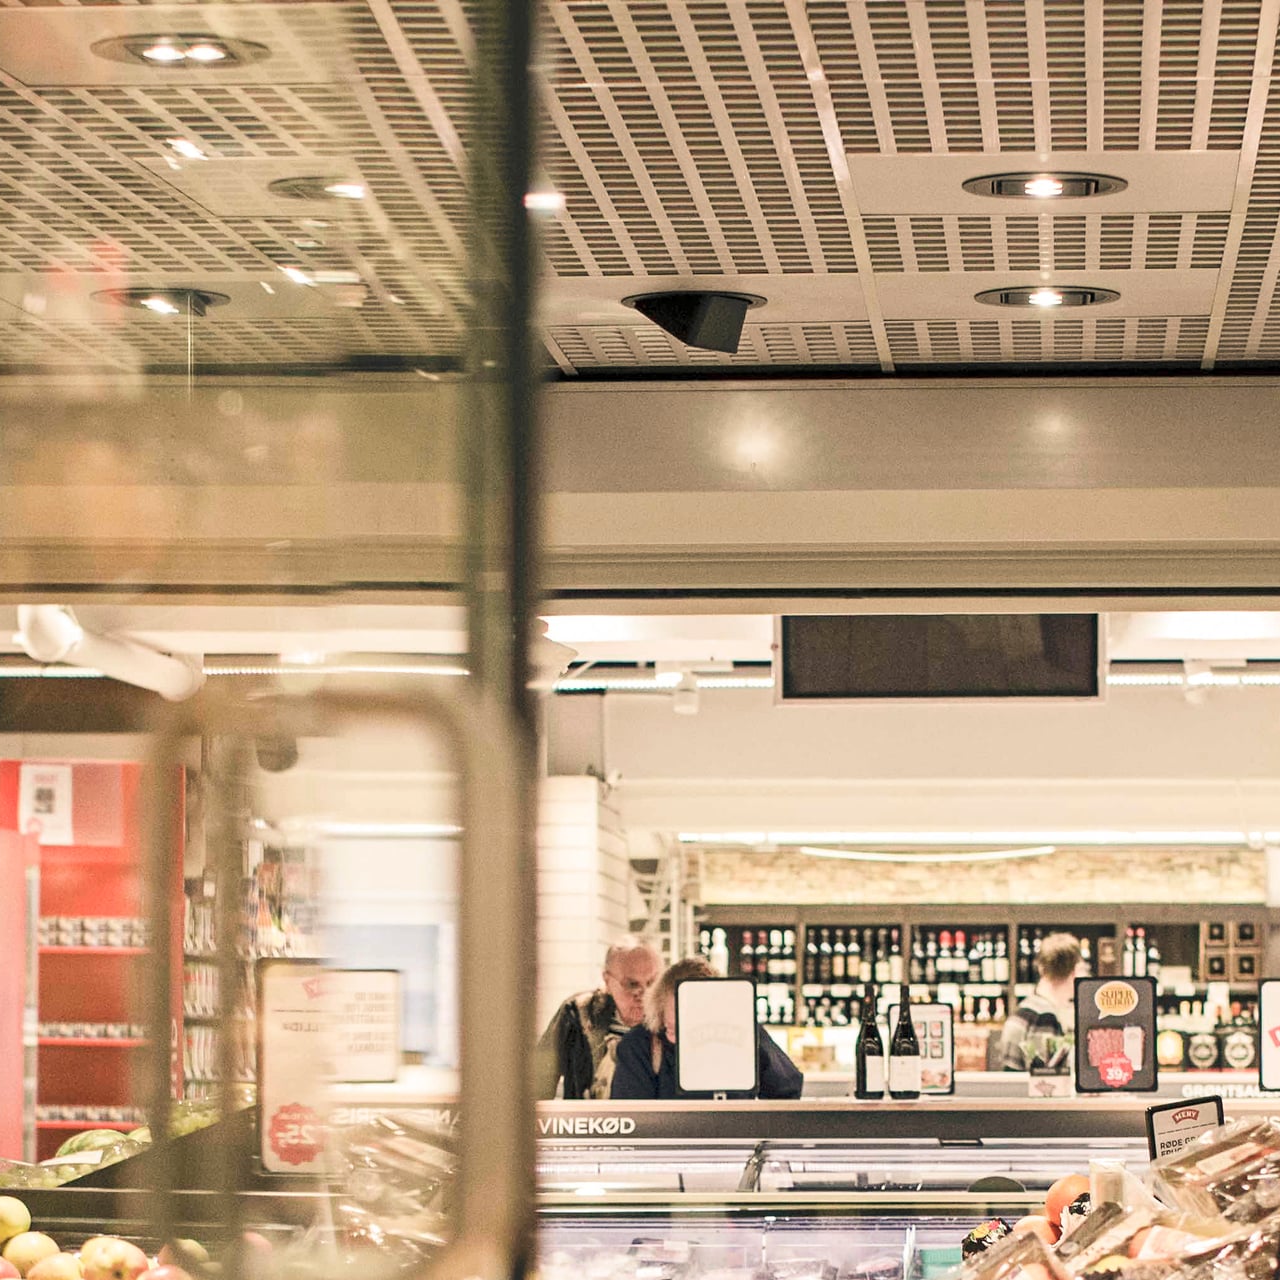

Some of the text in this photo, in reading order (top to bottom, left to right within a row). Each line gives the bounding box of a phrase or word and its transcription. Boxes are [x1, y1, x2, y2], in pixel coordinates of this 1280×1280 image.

[1175, 1110, 1197, 1120] MENY
[538, 1117, 636, 1134] VINEKØD
[1160, 1139, 1183, 1150] RØDE
